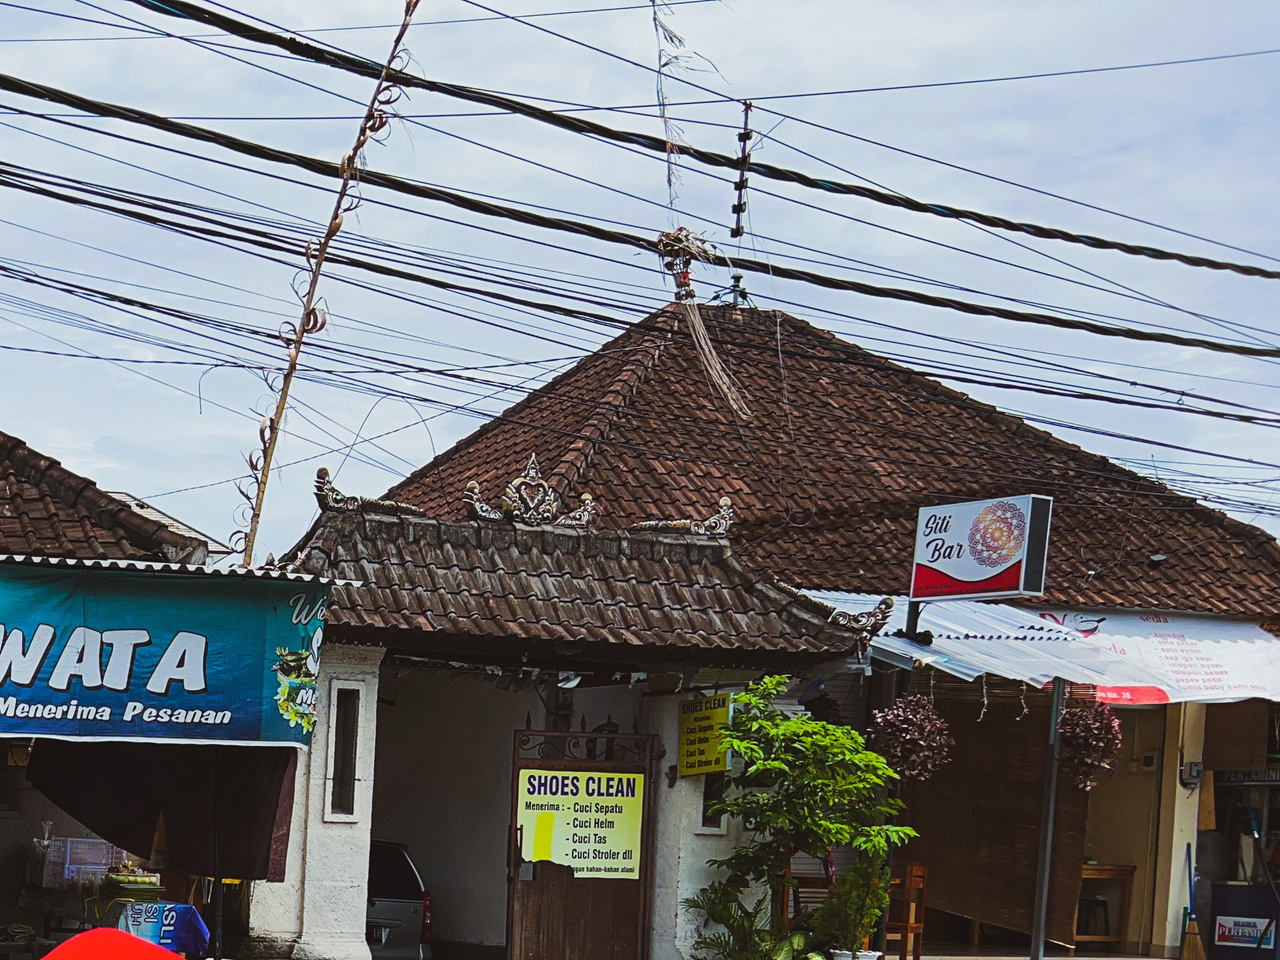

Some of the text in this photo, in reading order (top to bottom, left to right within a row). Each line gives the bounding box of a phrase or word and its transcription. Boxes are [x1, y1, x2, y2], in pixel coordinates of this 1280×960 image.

[923, 514, 952, 537] Siti
[926, 538, 965, 563] Bar
[1140, 614, 1168, 624] sedia
[123, 701, 232, 725] Pesanan
[682, 697, 727, 715] SHOES CLEAN
[527, 774, 637, 798] SHOES CLEAN
[525, 801, 623, 816] Menerima Cuci Sepatu
[572, 817, 615, 829] Cuci Helm
[572, 832, 608, 844] Cuci Tas
[571, 848, 633, 860] Cuci Stroler dll
